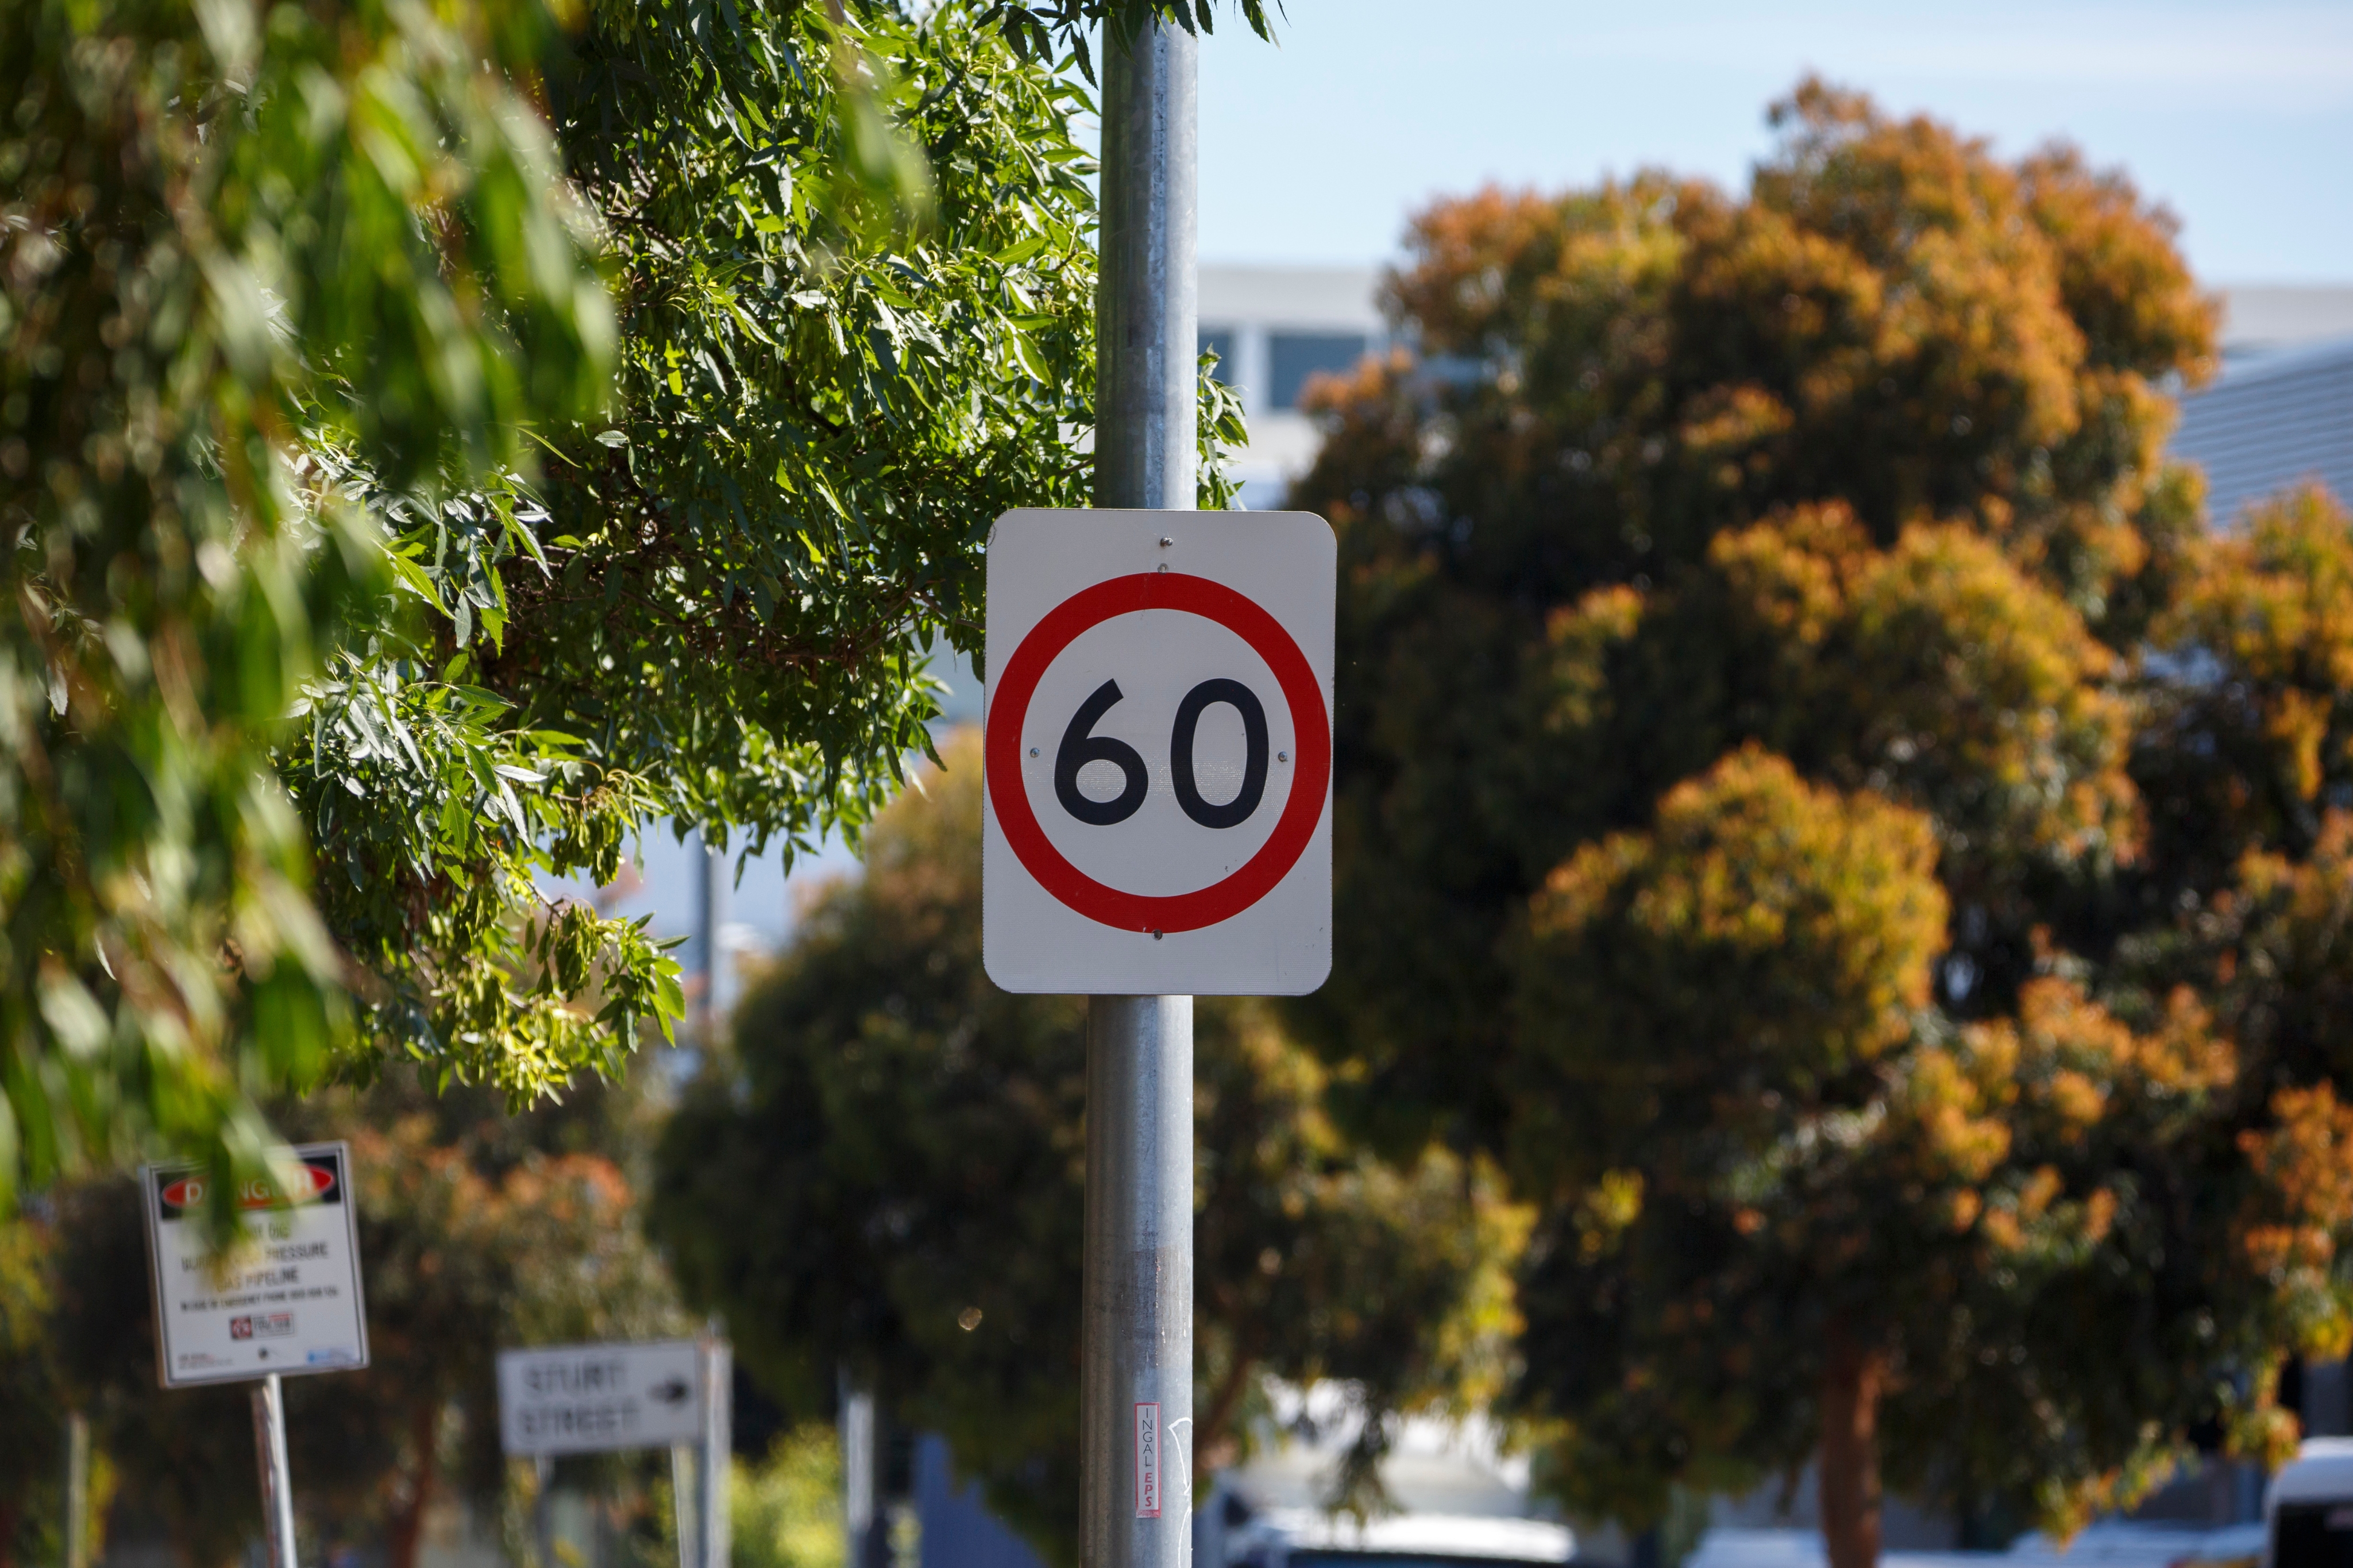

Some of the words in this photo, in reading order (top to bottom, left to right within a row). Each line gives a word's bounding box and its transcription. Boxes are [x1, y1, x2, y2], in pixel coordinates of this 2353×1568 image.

[1054, 678, 1269, 829] 60
[246, 1266, 299, 1288] PIPELINE
[1142, 1408, 1153, 1467] INGAL
[1144, 1473, 1154, 1507] EPS
